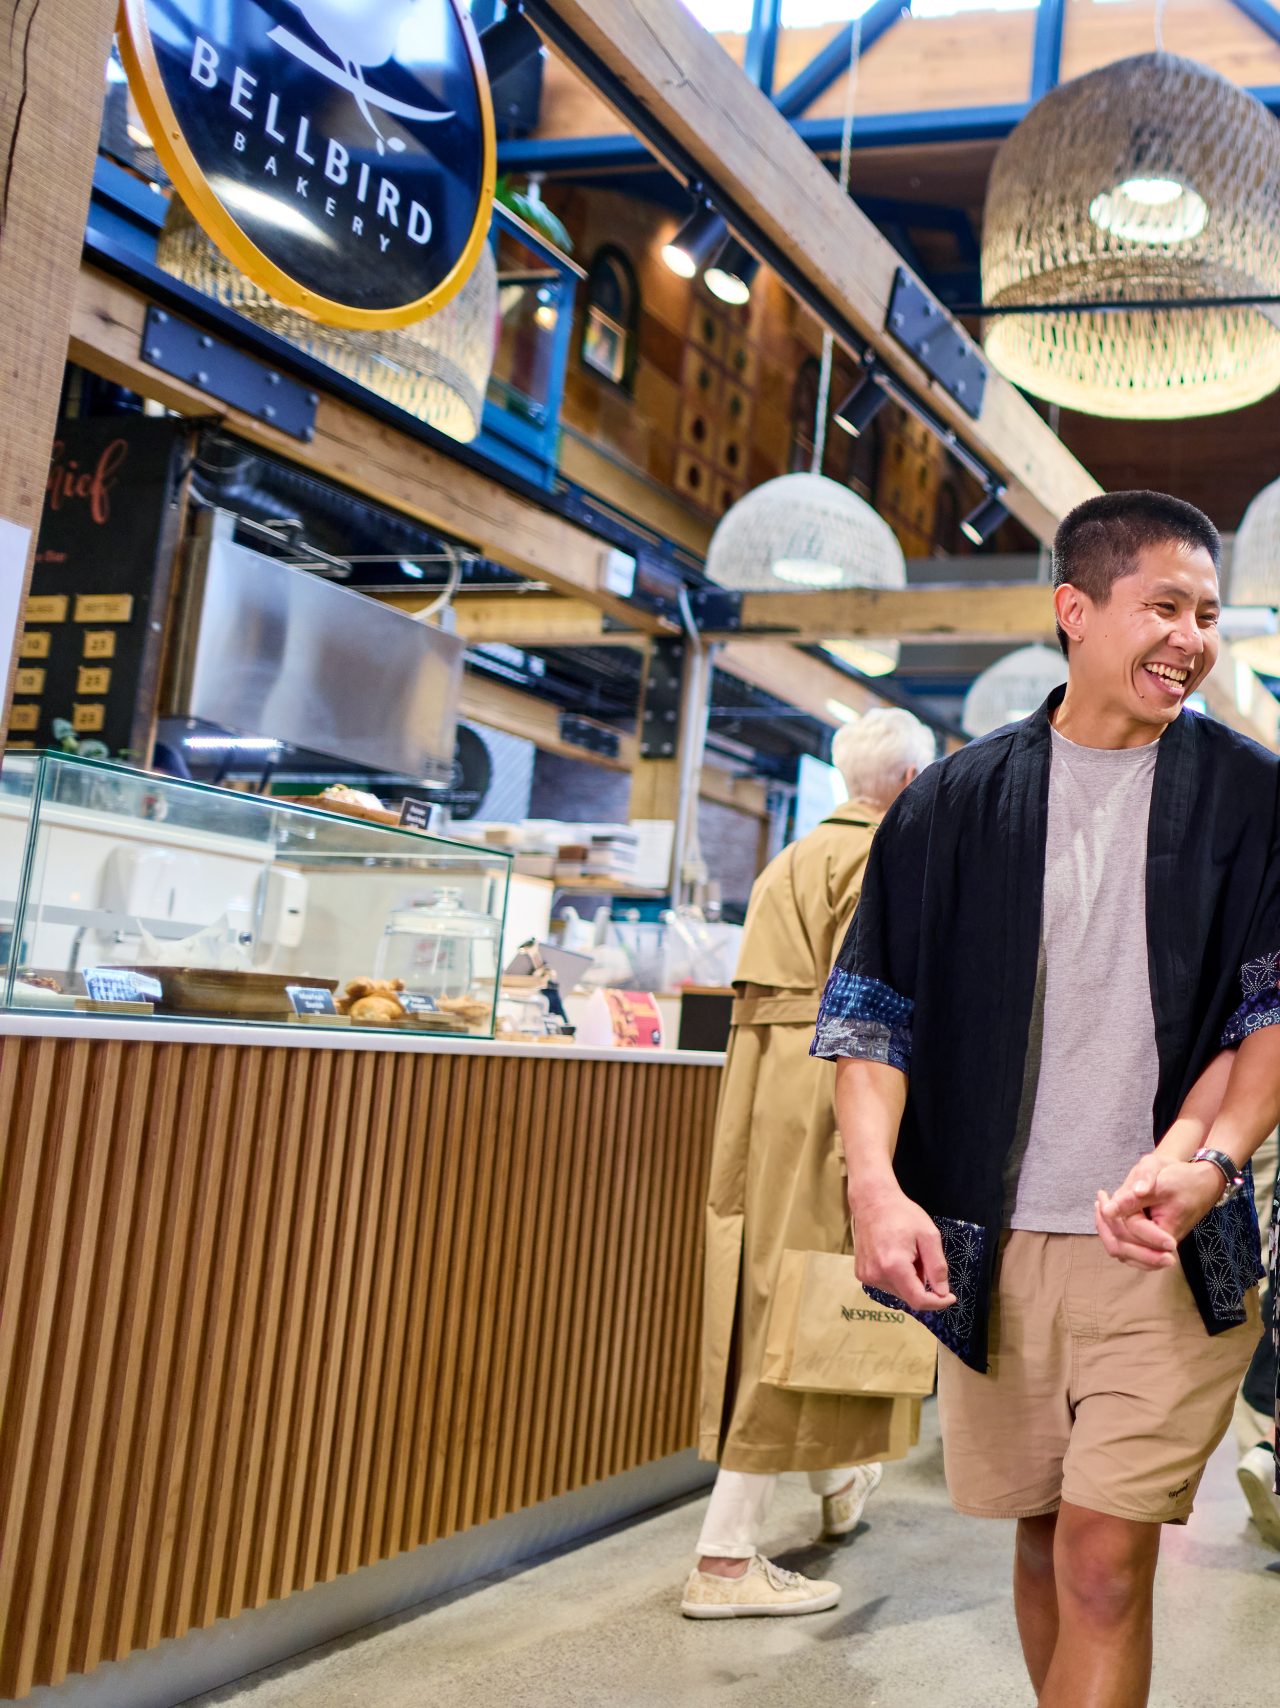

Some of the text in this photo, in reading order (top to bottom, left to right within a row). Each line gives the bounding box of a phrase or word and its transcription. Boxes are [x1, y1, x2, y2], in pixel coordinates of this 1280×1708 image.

[190, 35, 433, 245] BELLBIRD
[233, 131, 390, 253] BAKERY
[840, 1304, 905, 1325] NESPRESSO
